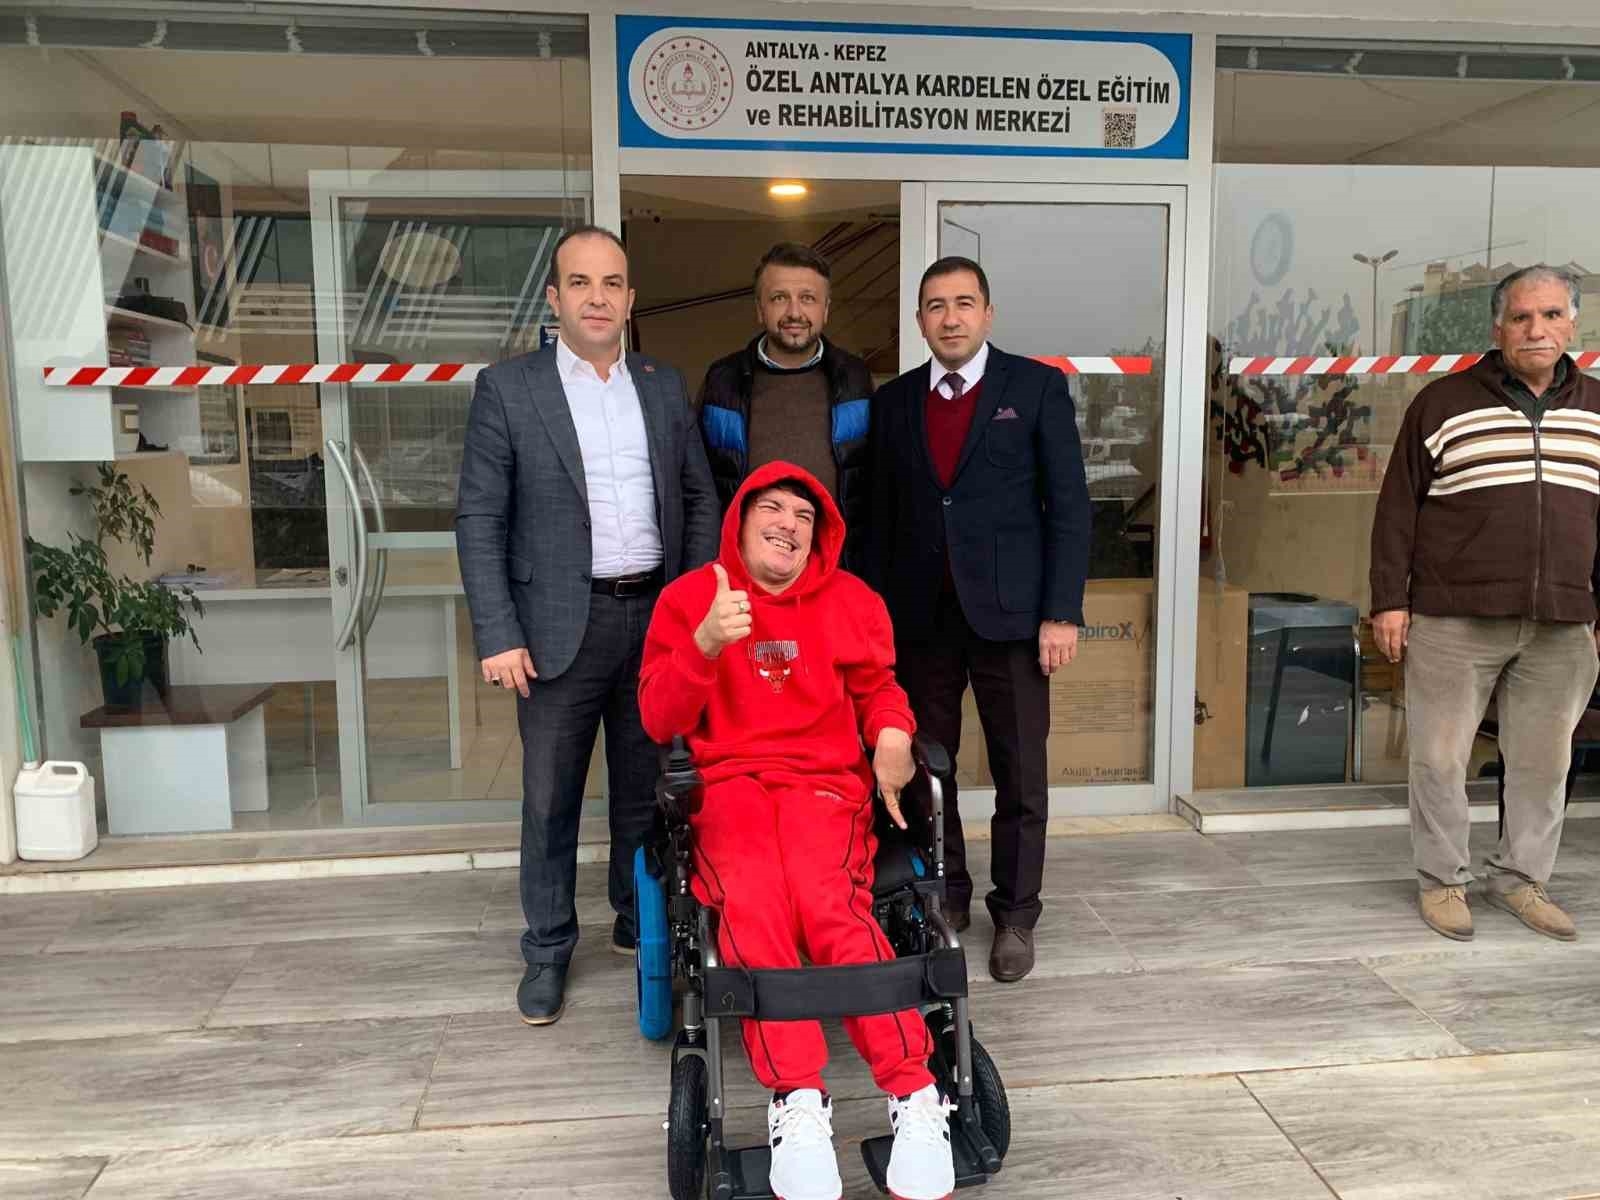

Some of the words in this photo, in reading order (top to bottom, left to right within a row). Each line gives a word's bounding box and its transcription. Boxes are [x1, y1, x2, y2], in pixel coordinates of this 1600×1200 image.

[746, 42, 819, 60] ANTALYA
[834, 44, 886, 62] KEPEZ
[746, 64, 803, 94] ÖZEL
[810, 71, 910, 96] ANTALYA
[916, 75, 1030, 100] KARDELEN
[1036, 73, 1091, 102] ÖZEL
[1098, 75, 1170, 104] EĞİTİM
[746, 109, 771, 126] ve
[778, 100, 969, 130] REHABİLİTASYON
[976, 106, 1070, 133] MERKEZİ
